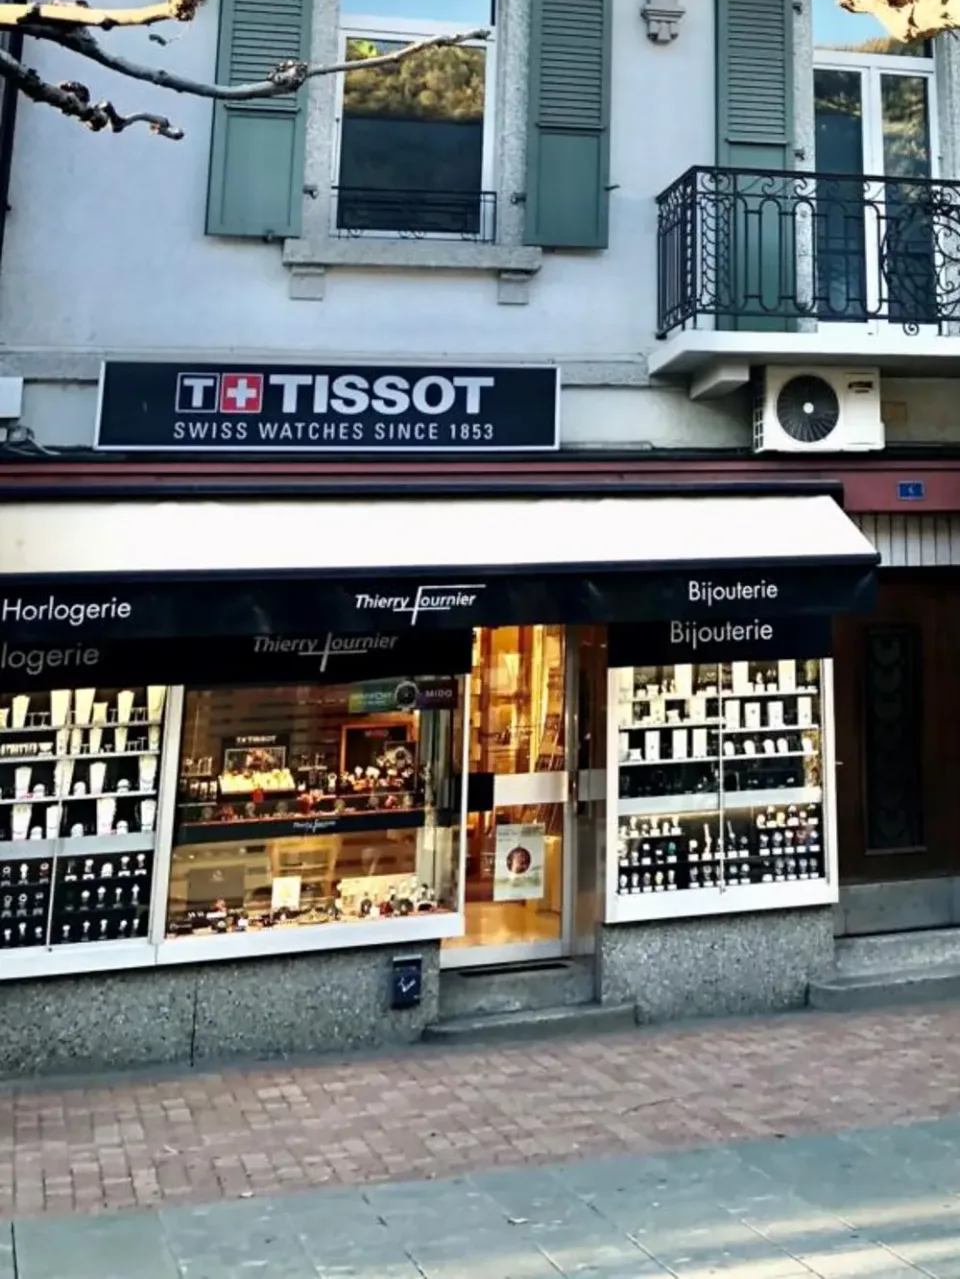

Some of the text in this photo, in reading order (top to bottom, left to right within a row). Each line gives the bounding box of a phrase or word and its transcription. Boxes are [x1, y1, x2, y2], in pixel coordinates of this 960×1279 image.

[269, 374, 495, 415] TISSOT
[173, 422, 494, 440] SWISS WATCHES SINCE 1853
[355, 584, 486, 626] Thierry Fournier
[688, 579, 778, 607] Bijouterie
[2, 595, 131, 626] Horlogerie
[254, 636, 318, 652] Thierry
[671, 618, 773, 650] Bijouterie
[1, 642, 100, 675] logerie
[425, 689, 453, 698] MIDO
